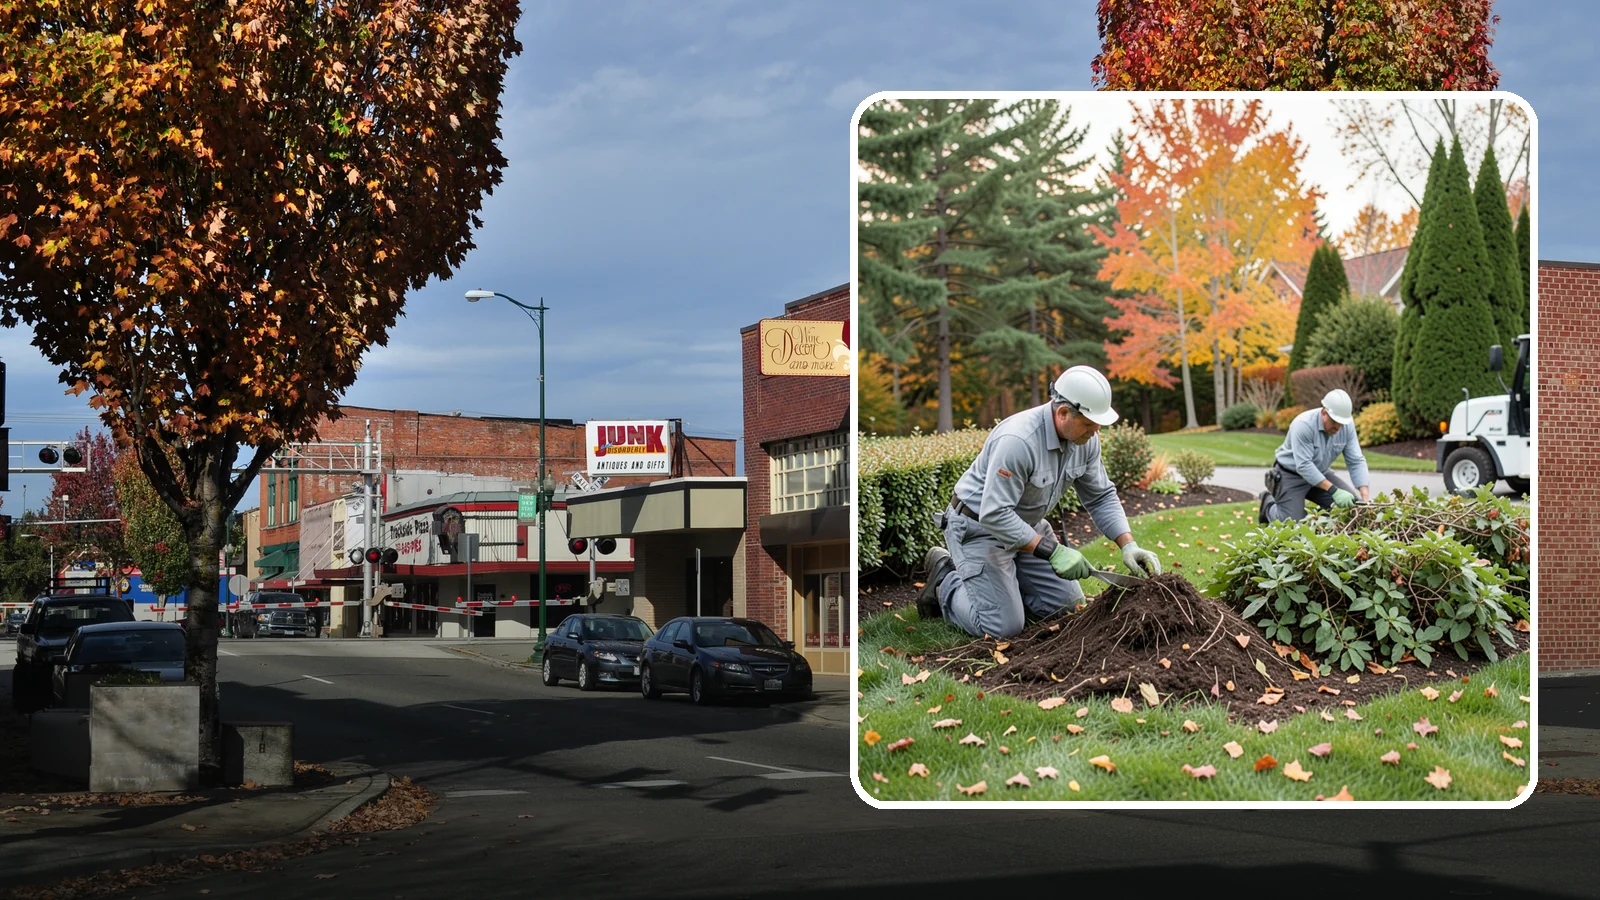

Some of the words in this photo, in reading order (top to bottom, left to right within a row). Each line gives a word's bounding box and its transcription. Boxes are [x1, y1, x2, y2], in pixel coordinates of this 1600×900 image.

[764, 327, 831, 365] Decor
[595, 425, 664, 457] JUNK
[607, 446, 646, 454] DISORDERLY
[596, 461, 628, 470] ANTIQUES
[631, 461, 644, 470] AND
[646, 460, 665, 469] GIFTS
[573, 473, 588, 490] RAIL
[390, 521, 413, 540] Trackside
[414, 519, 429, 535] Pizza
